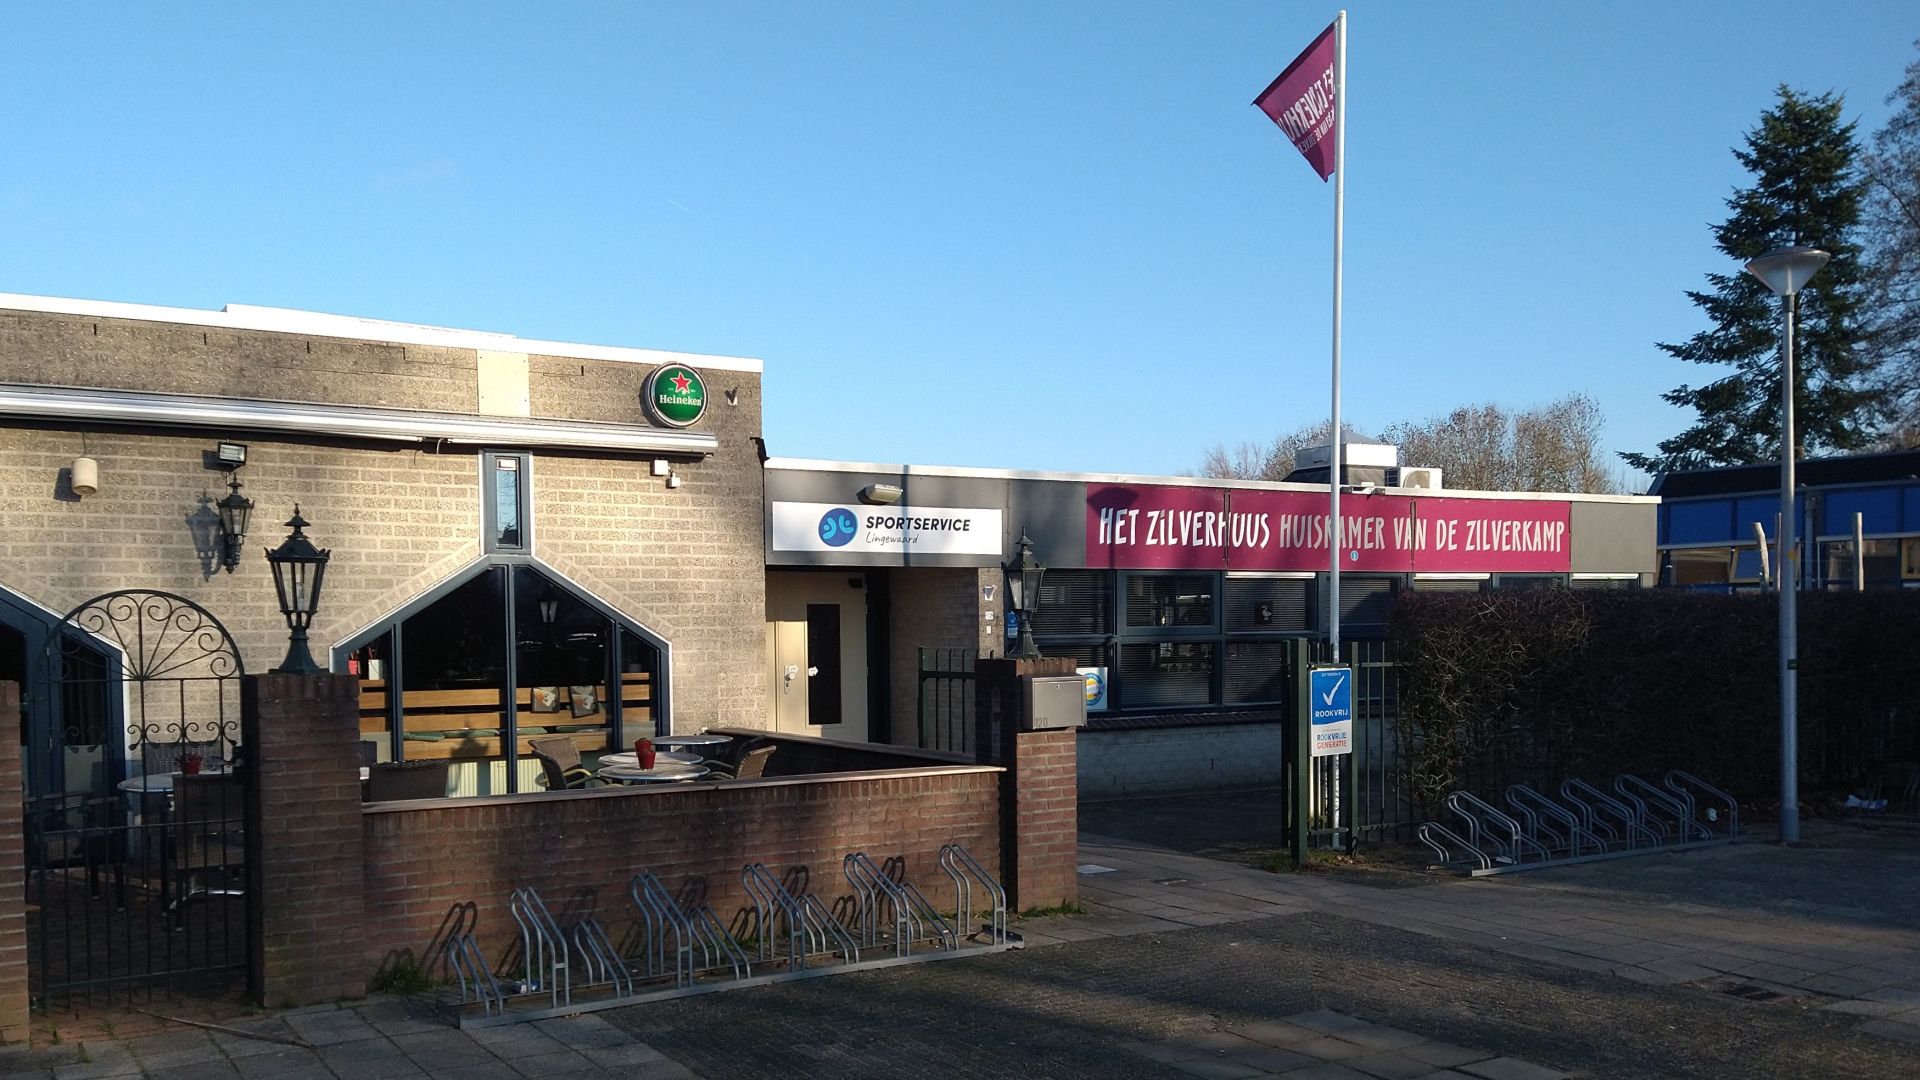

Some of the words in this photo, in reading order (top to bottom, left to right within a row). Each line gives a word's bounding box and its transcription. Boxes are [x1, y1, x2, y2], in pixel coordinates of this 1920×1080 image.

[659, 394, 702, 407] Heineken
[866, 516, 970, 532] SPORTSERVICE
[1100, 507, 1140, 545] HET
[1393, 517, 1427, 551] VAN
[1436, 519, 1458, 551] DE
[1465, 519, 1565, 553] ZILVERKAMP
[866, 531, 919, 546] Lingewaard
[1315, 709, 1348, 718] ROOKVRIJ
[1316, 732, 1347, 741] ROOKVRIJE
[1316, 740, 1347, 749] GENERATIE
